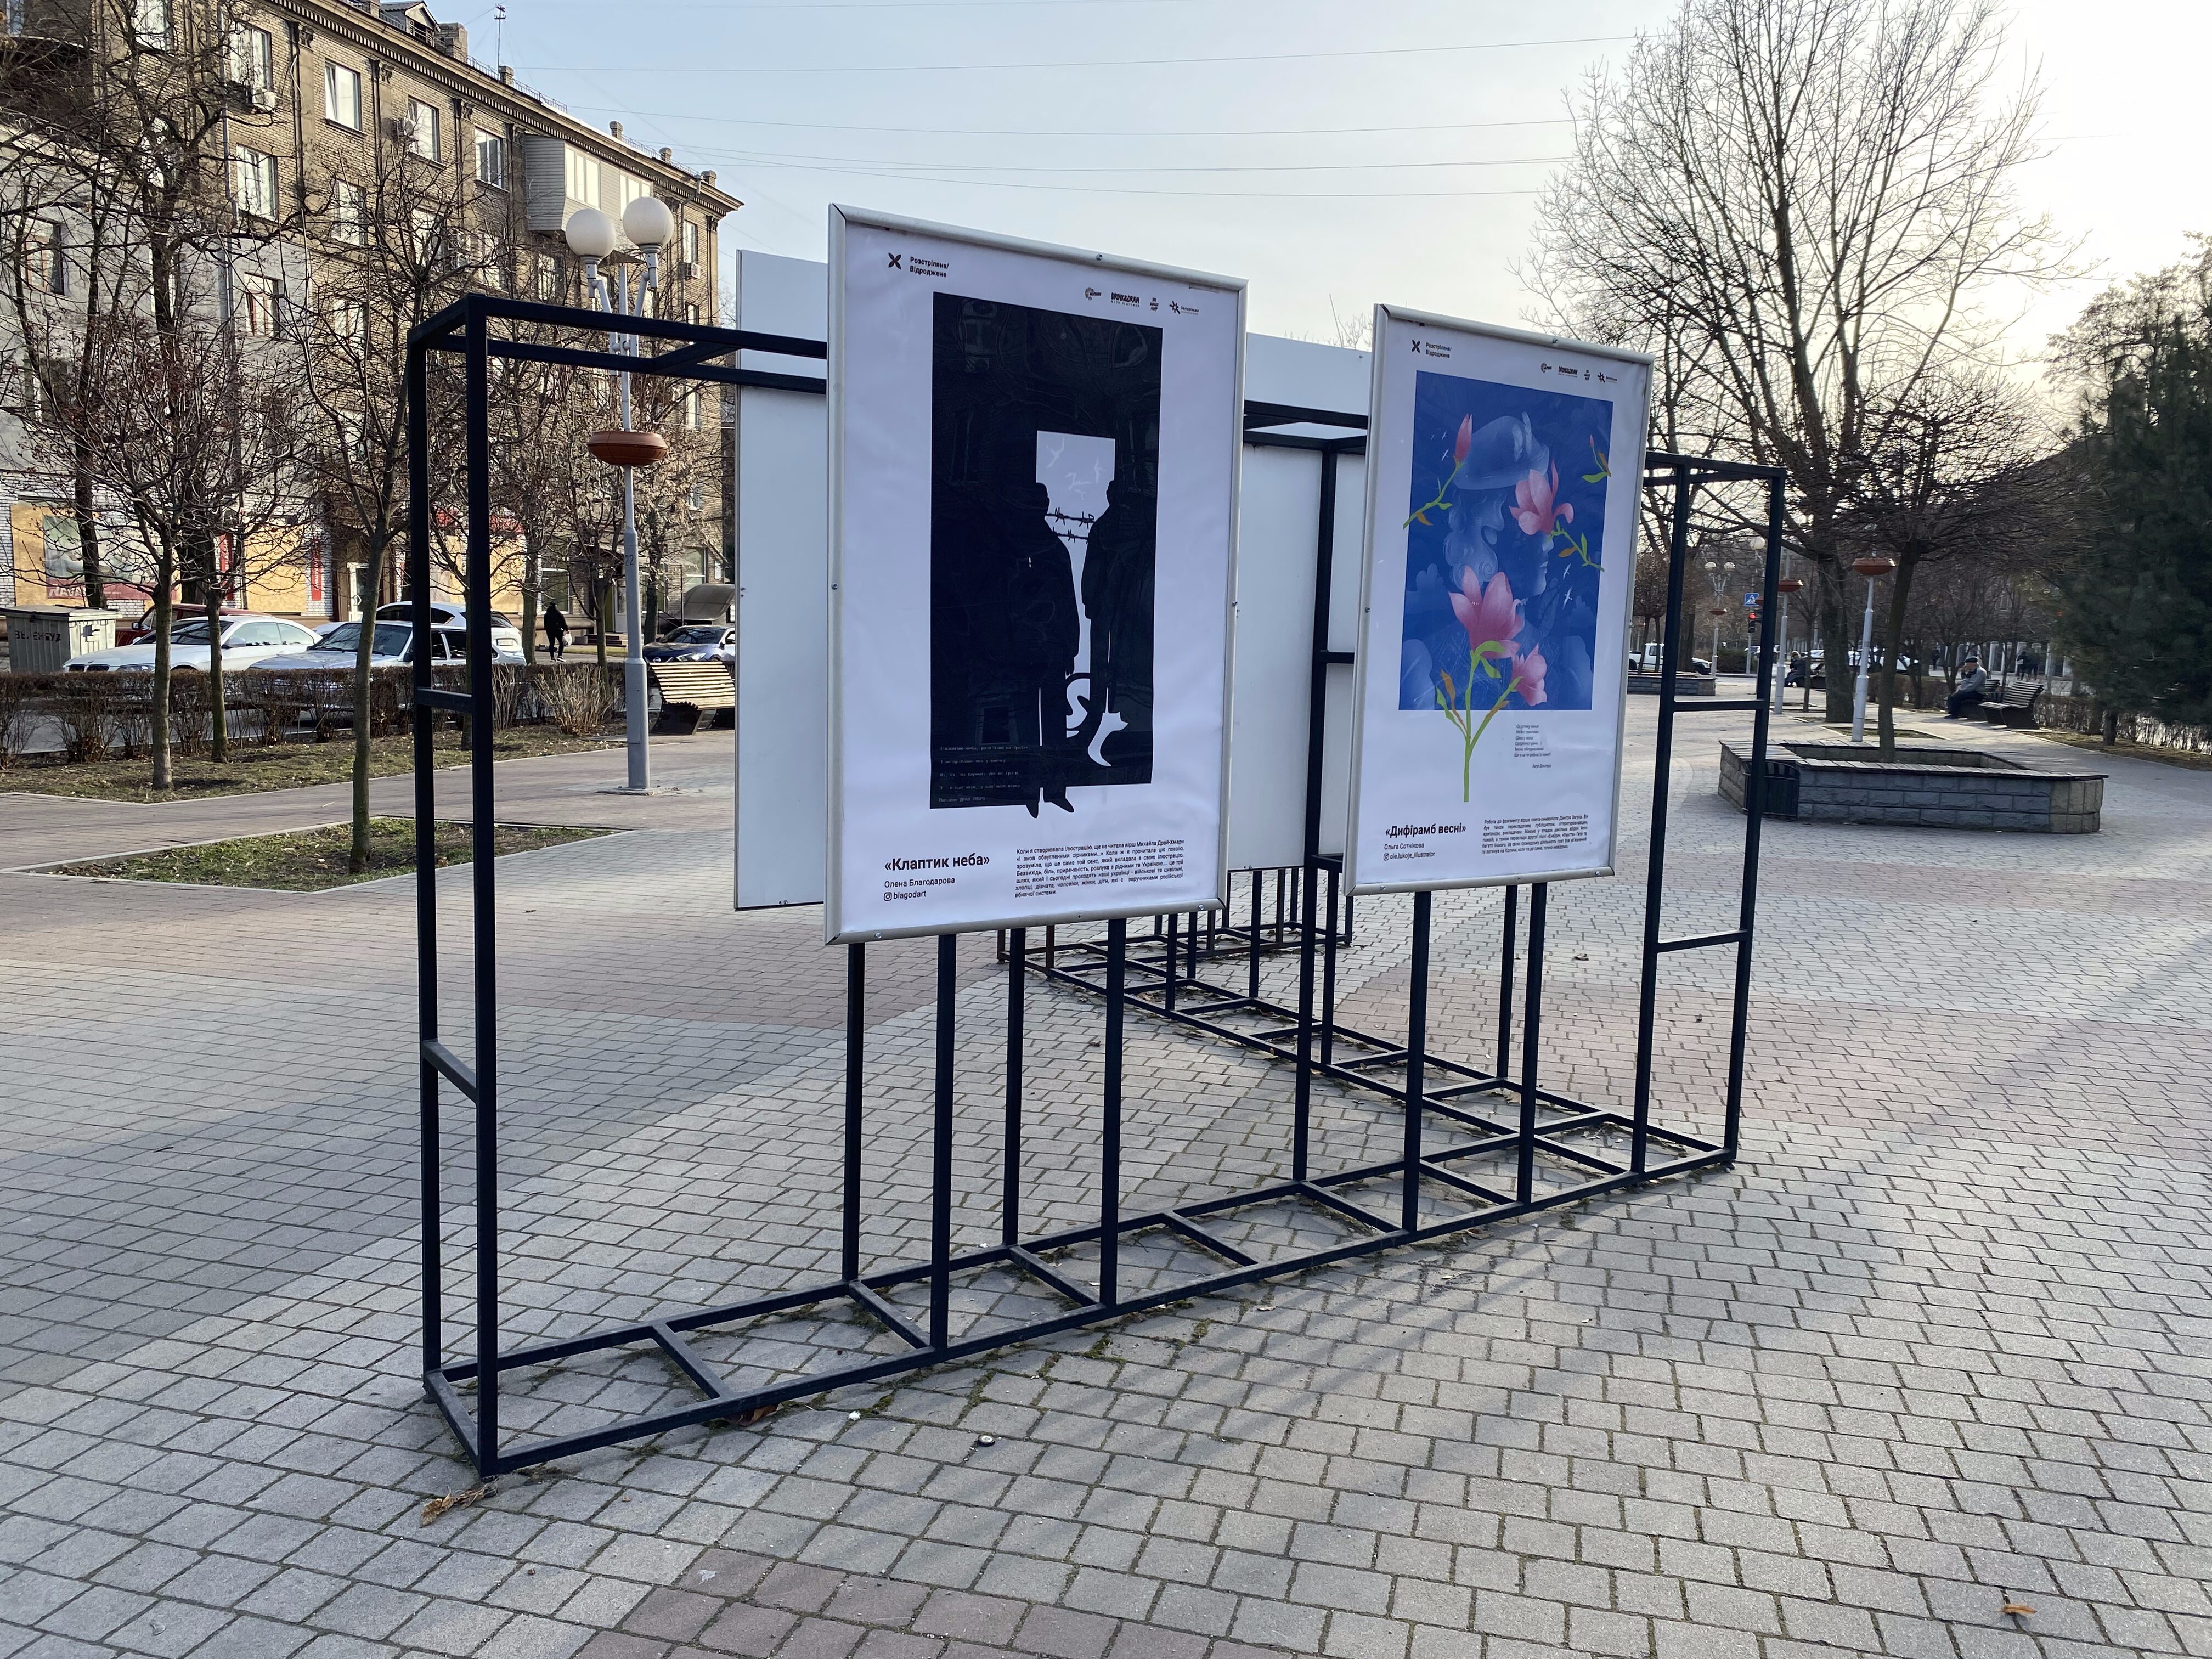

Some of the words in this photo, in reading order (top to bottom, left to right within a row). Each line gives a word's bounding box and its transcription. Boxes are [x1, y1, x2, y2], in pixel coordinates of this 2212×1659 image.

[910, 256, 949, 270] Розстріляне/
[910, 266, 947, 279] Відроджене
[1111, 291, 1140, 304] DRINK&DRAW
[1425, 349, 1449, 358] Відроджене
[625, 554, 634, 567] 22
[1385, 822, 1436, 838] «Дифірамб
[1438, 822, 1466, 834] весні»
[884, 857, 949, 871] «Клаптик
[952, 853, 990, 867] неба»
[1017, 862, 1042, 870] зрозуміла,
[1056, 866, 1089, 874] приреченість,
[1110, 869, 1130, 878] українці
[884, 880, 907, 888] Олена
[909, 877, 955, 886] Благодарова
[893, 890, 927, 900] blagodart
